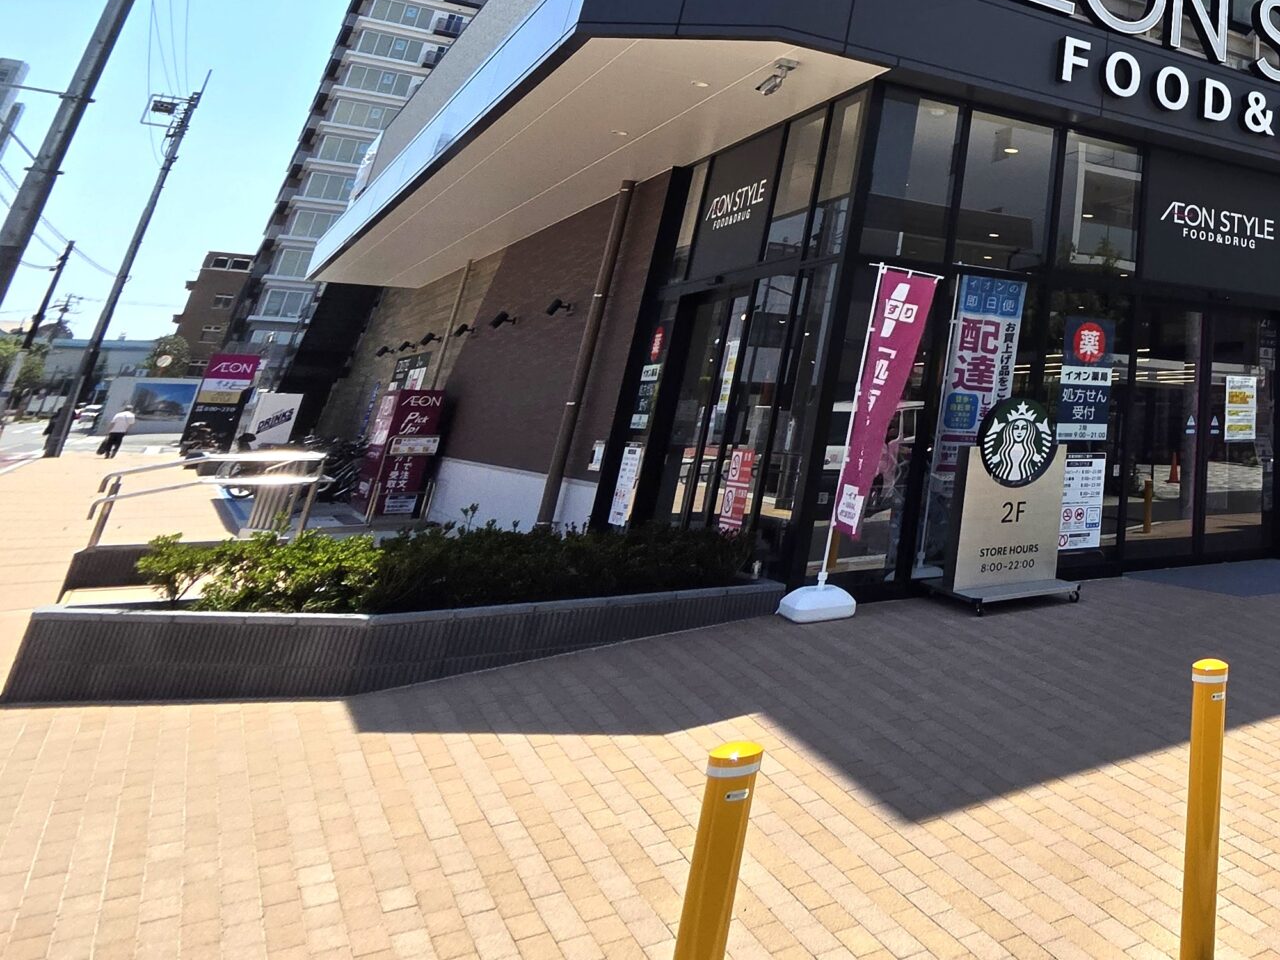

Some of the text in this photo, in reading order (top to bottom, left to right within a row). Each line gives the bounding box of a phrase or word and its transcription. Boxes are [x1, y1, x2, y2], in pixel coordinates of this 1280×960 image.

[733, 179, 767, 212] STYLE
[712, 208, 751, 231] FOOD&DRUG
[1220, 210, 1275, 240] STYLE
[1183, 227, 1256, 249] FOOD&DRUG
[970, 279, 1019, 294] イオンの
[966, 294, 1015, 312] 即日便
[1079, 329, 1101, 356] 薬
[952, 317, 1001, 393] 配達
[1065, 370, 1109, 383] イオン薬局
[1061, 387, 1107, 403] 処方せん
[257, 408, 295, 433] DRINKS
[1072, 405, 1096, 420] 受付
[1001, 501, 1027, 523] 2F
[979, 544, 1039, 557] STORE HOURS
